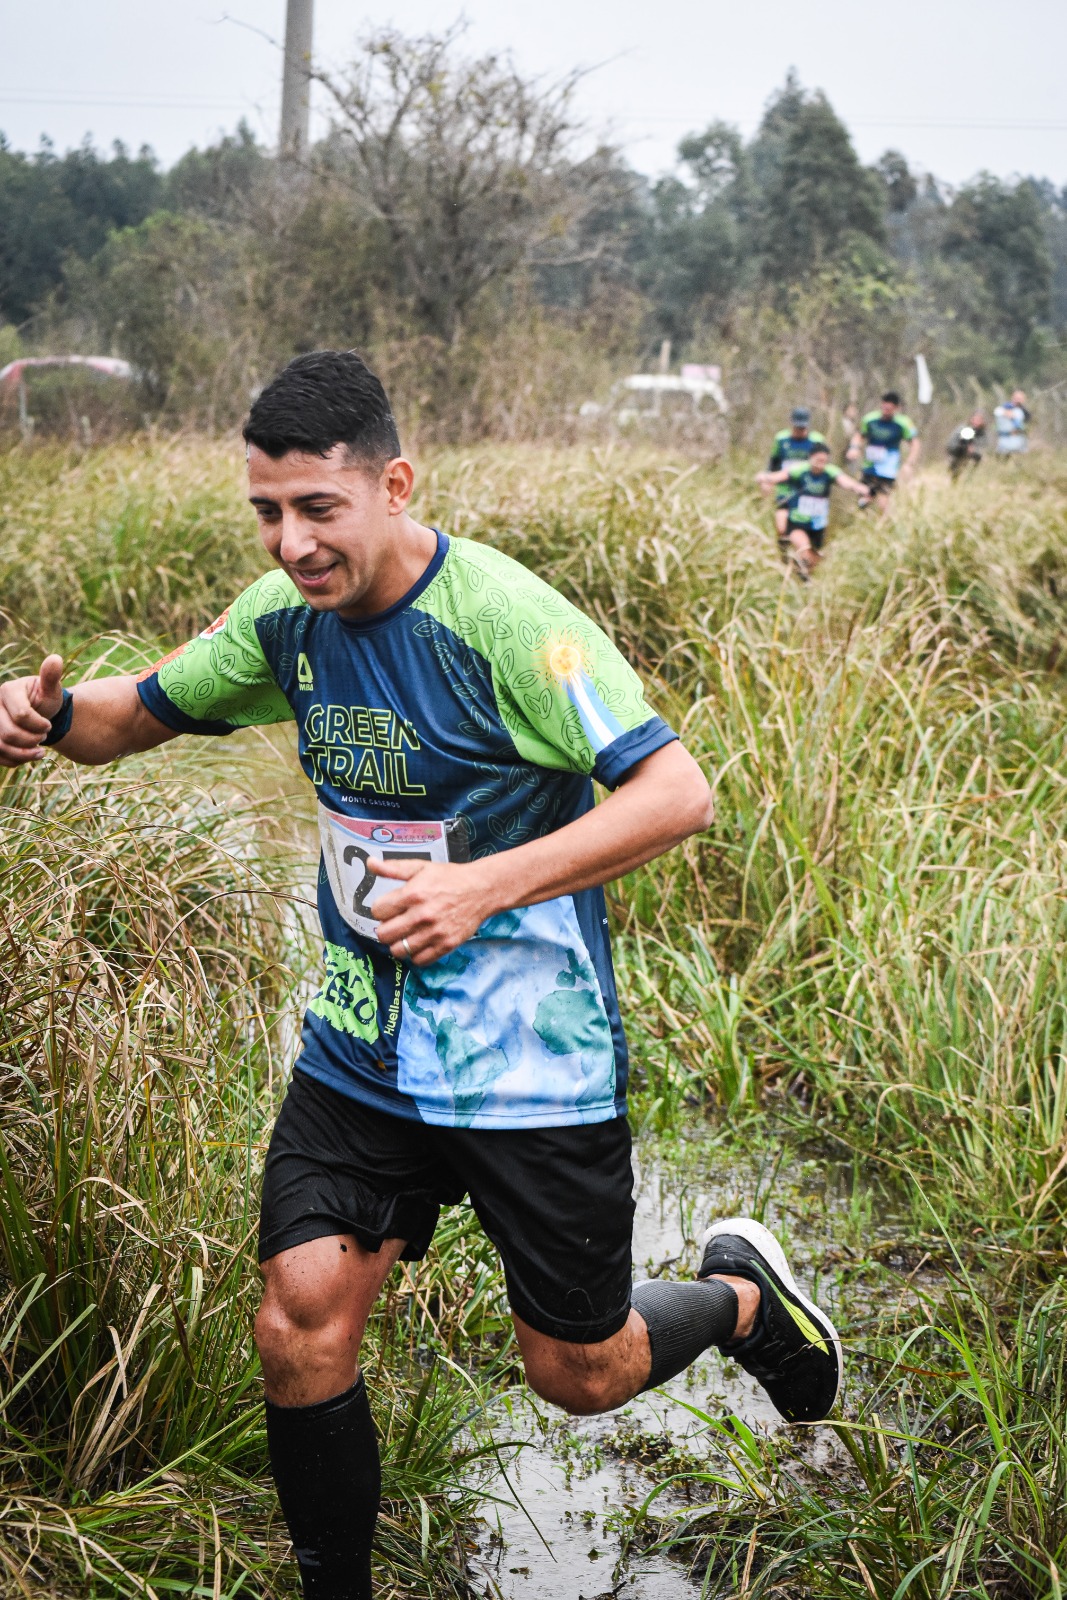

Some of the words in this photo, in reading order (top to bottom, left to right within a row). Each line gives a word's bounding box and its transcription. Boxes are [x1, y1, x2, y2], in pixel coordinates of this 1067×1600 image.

[304, 703, 421, 750] GREEN
[303, 744, 427, 796] TRAIL
[341, 795, 367, 804] MONTE
[368, 798, 401, 809] CASEROS
[383, 989, 401, 1037] Huellas
